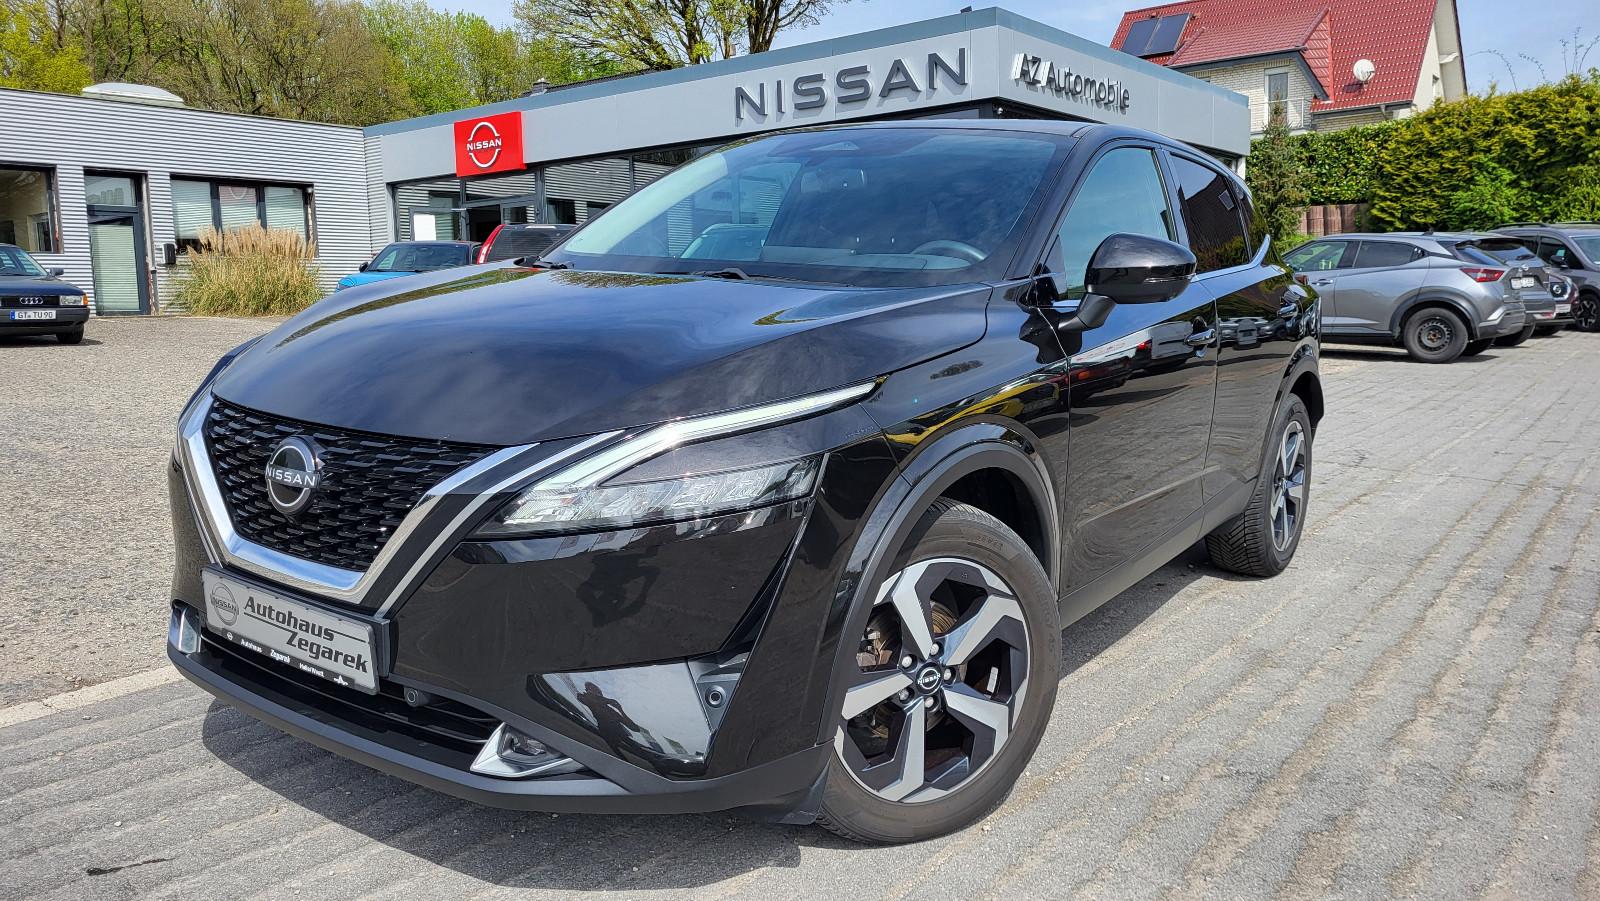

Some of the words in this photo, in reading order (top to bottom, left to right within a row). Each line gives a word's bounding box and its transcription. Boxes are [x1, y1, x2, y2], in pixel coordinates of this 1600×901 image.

[735, 48, 968, 120] NISSAN
[1012, 53, 1042, 86] AZ
[1041, 61, 1130, 109] Automobile
[466, 138, 502, 151] NISSAN
[265, 463, 316, 487] NISSAN
[211, 596, 238, 612] NISSAN
[243, 596, 335, 641] Autohaus
[286, 630, 369, 674] Zegarek
